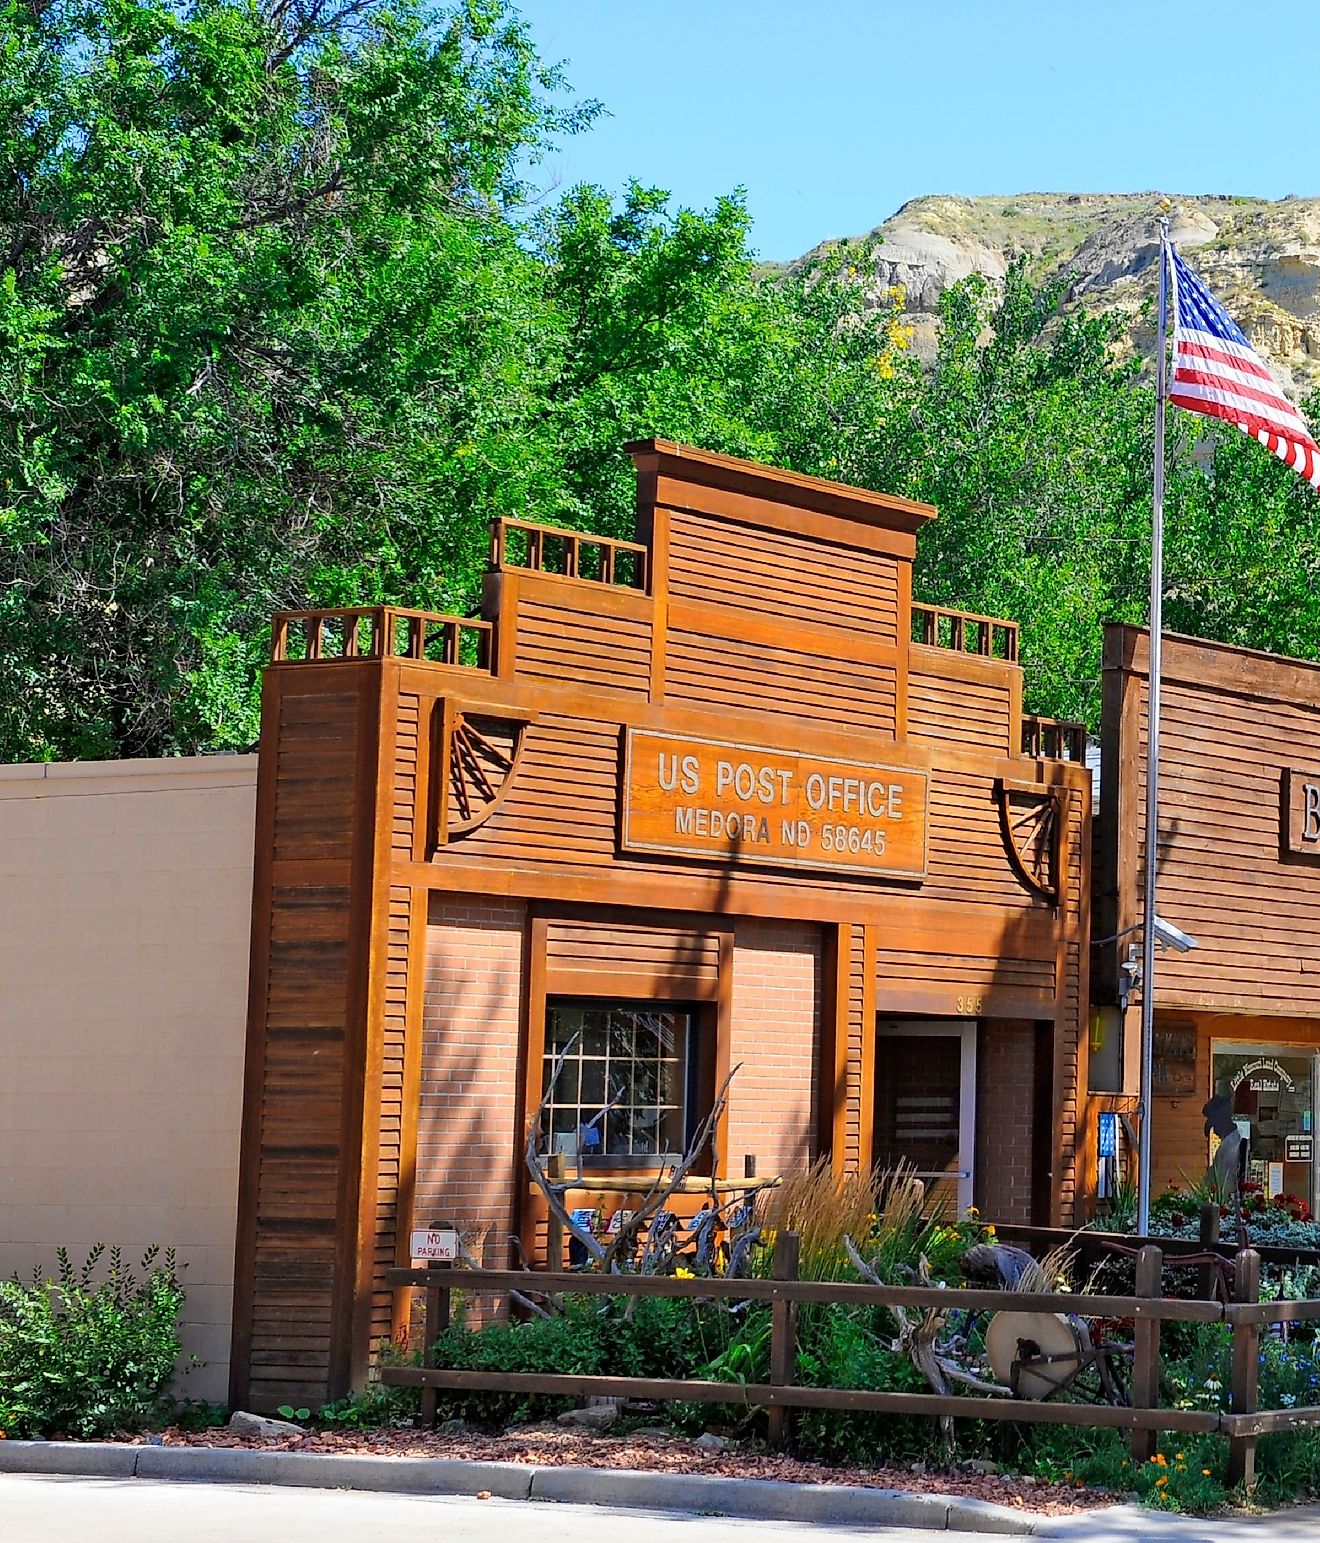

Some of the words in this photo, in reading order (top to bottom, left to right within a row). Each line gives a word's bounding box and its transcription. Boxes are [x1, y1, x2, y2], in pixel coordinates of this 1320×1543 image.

[657, 752, 701, 794] US
[716, 761, 794, 805] POST
[805, 773, 904, 819] OFFICE
[674, 806, 771, 844] MEDORA
[781, 819, 811, 848] ND
[821, 824, 887, 856] 58645
[956, 996, 983, 1014] 355
[427, 1233, 441, 1245] NO
[417, 1247, 450, 1257] PARKING
